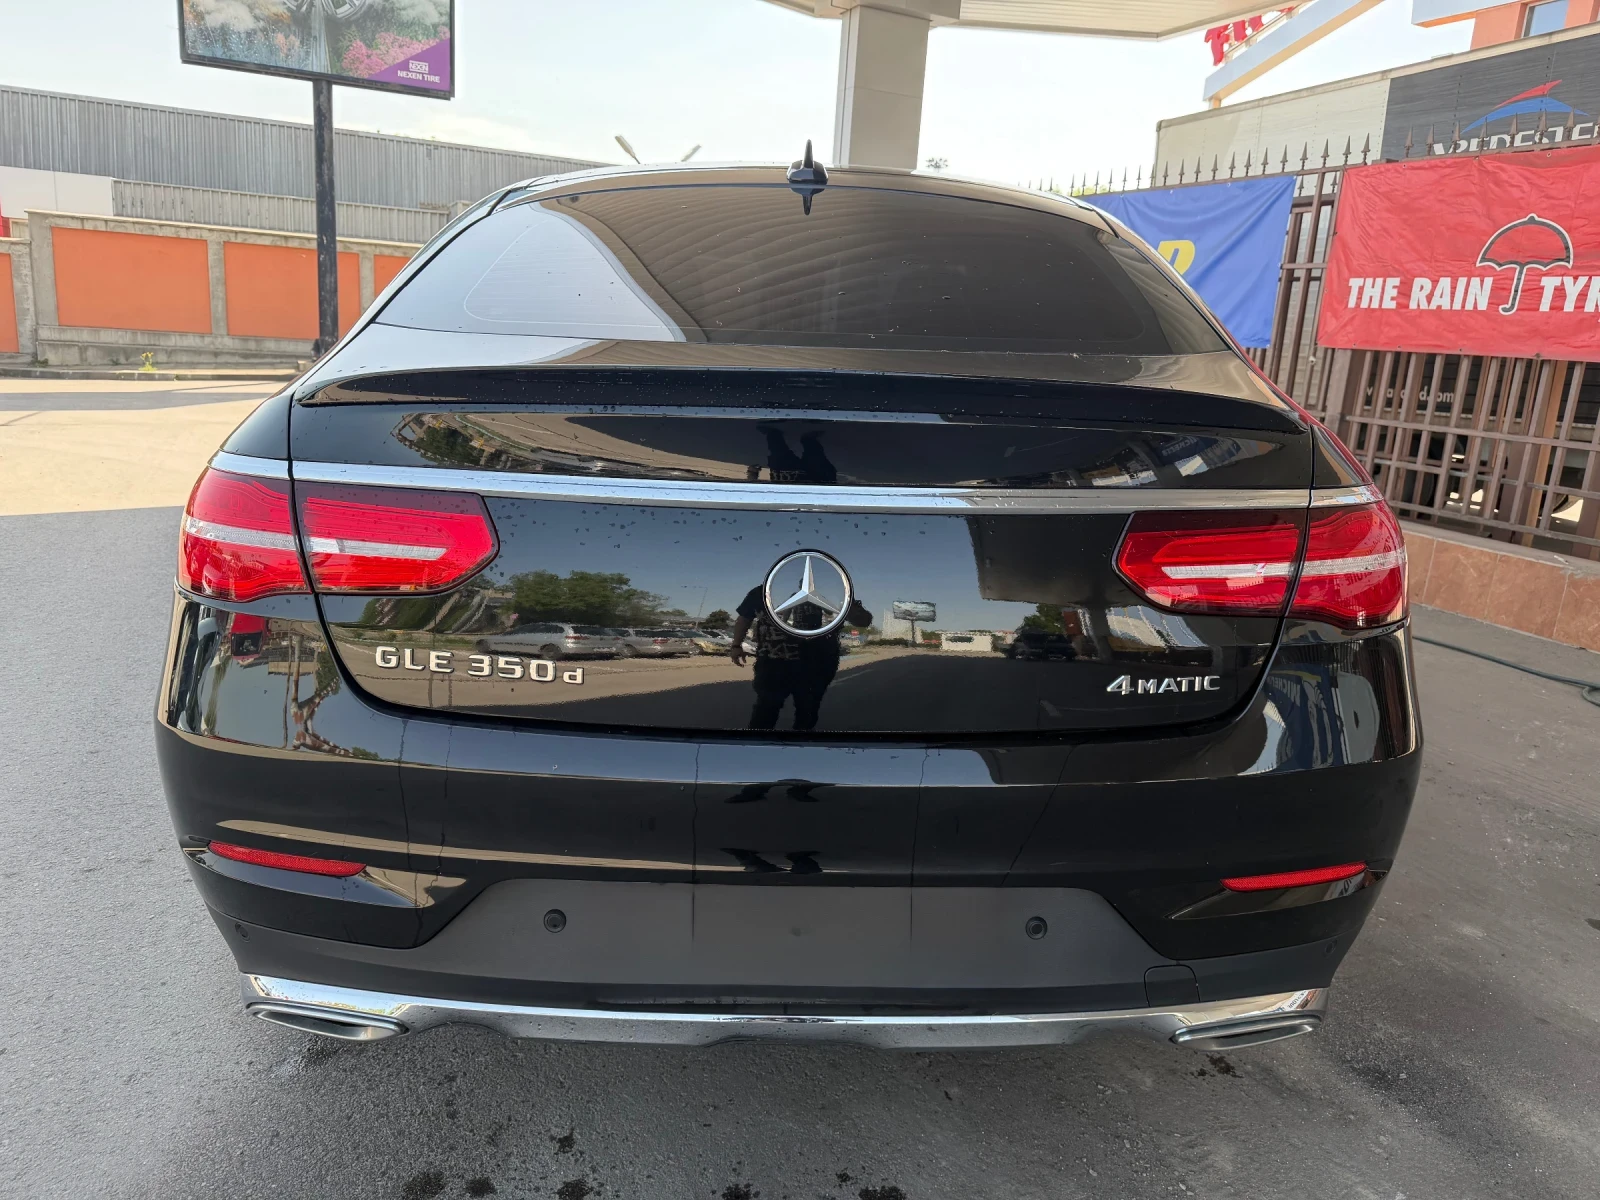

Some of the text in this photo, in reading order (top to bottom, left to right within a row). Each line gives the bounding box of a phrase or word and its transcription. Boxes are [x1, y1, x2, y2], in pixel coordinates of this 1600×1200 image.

[398, 70, 441, 83] NEXEN TIRE
[1347, 277, 1400, 309] THE
[1409, 276, 1493, 311] RAIN
[375, 646, 584, 685] GLE 350d
[1106, 675, 1221, 696] 4MATIC
